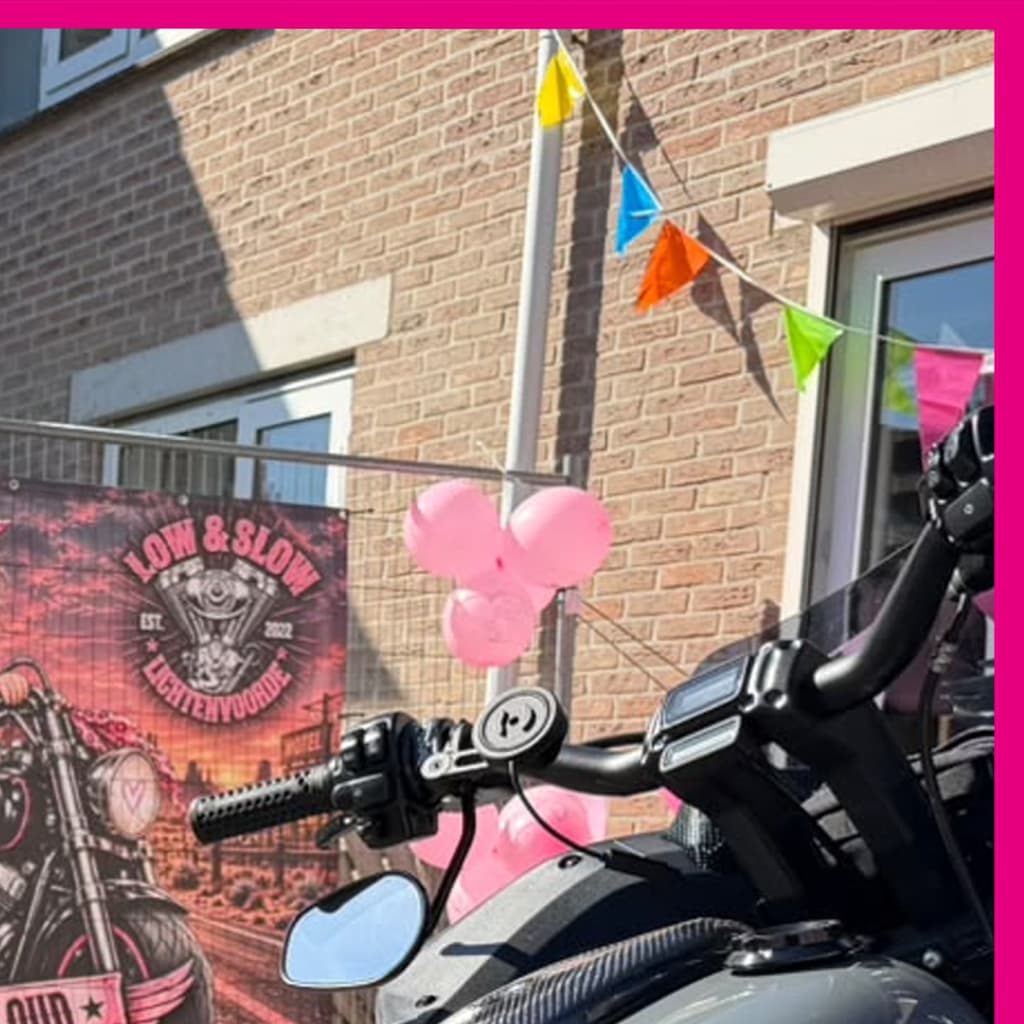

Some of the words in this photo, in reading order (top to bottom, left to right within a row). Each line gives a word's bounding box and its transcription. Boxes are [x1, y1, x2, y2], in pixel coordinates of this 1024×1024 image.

[122, 517, 198, 584] LOW
[202, 514, 229, 552] &
[232, 518, 322, 598] SLOW
[139, 612, 164, 632] EST.
